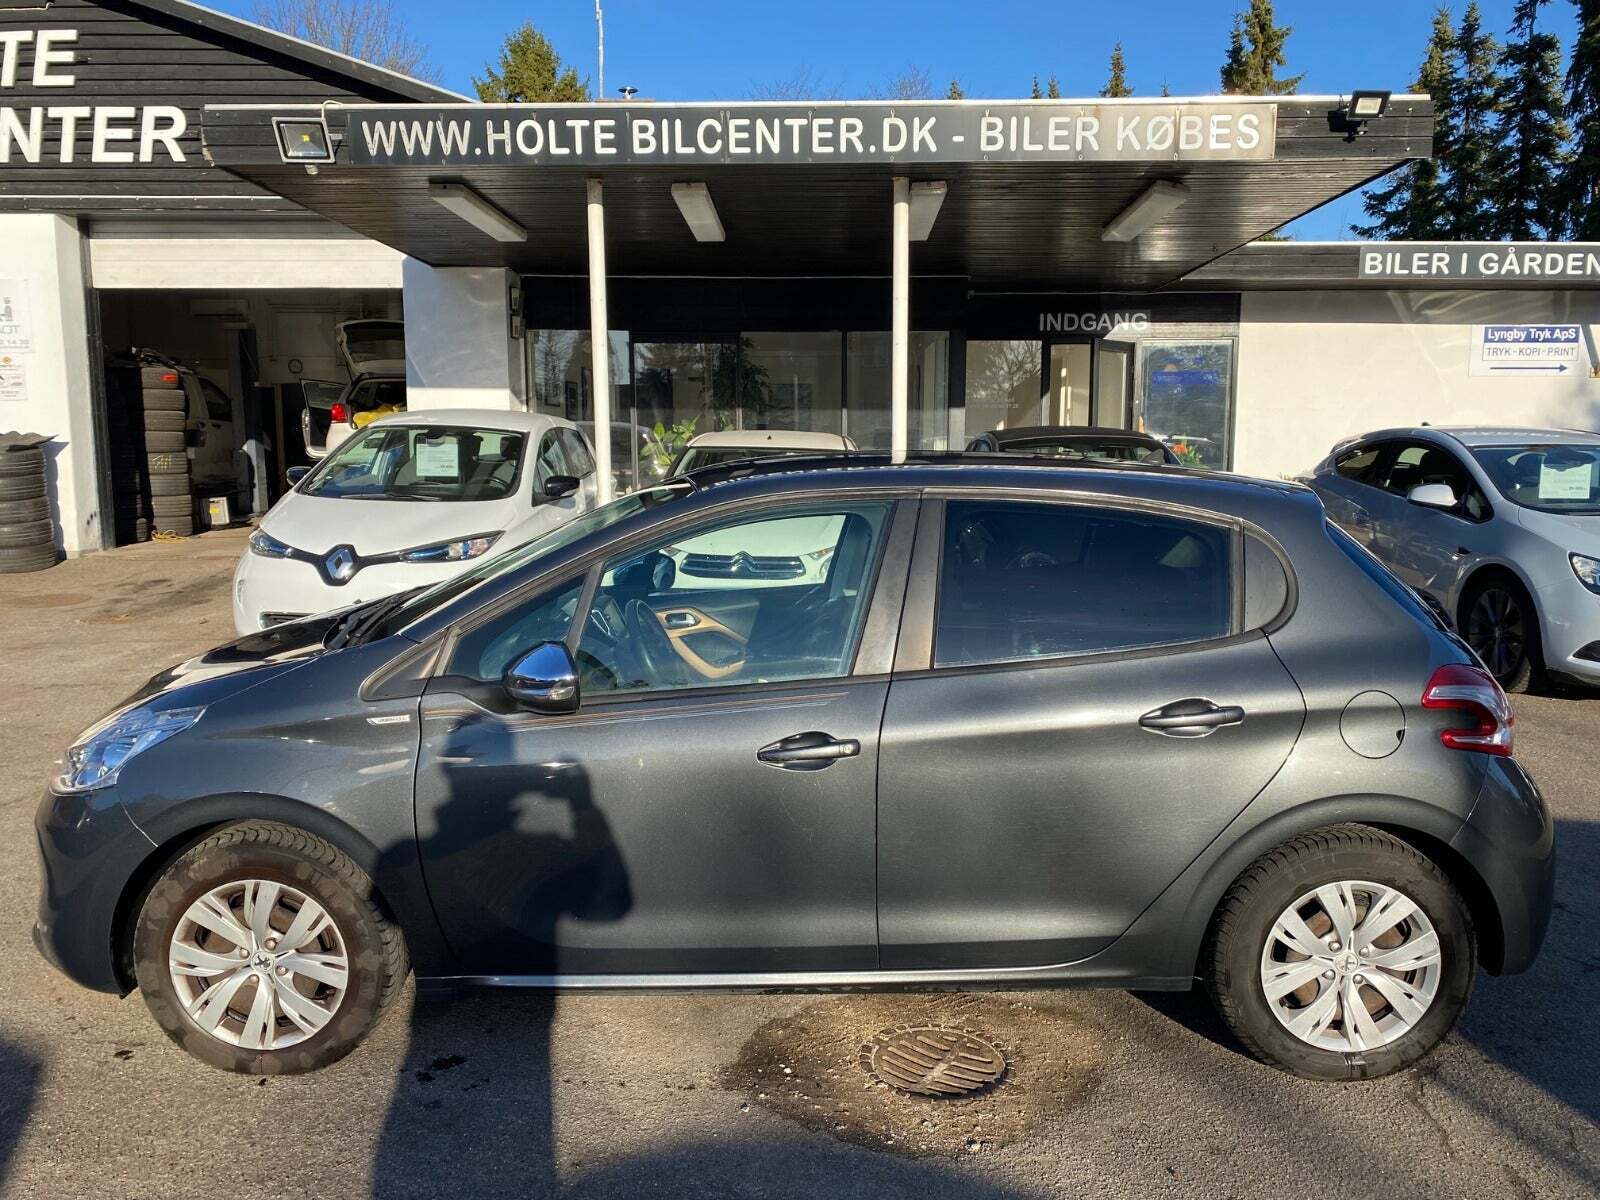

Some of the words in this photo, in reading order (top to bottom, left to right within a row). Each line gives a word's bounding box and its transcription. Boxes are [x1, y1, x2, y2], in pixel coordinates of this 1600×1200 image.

[361, 119, 617, 157] WWW.HOLTE
[632, 116, 937, 154] BILCENTER.DK
[980, 115, 1100, 152] BILER
[1116, 114, 1260, 151] KØBES
[1364, 252, 1450, 275] BILER
[1460, 252, 1468, 275] I
[1478, 247, 1600, 276] GÅRDEN
[1039, 312, 1148, 332] INDGANG
[1487, 328, 1527, 342] Lyngby
[1529, 328, 1551, 342] Tryk
[1553, 328, 1576, 342] ApS
[1487, 347, 1511, 357] TRYK
[1518, 347, 1540, 357] KOPI
[1547, 346, 1576, 357] PRINT
